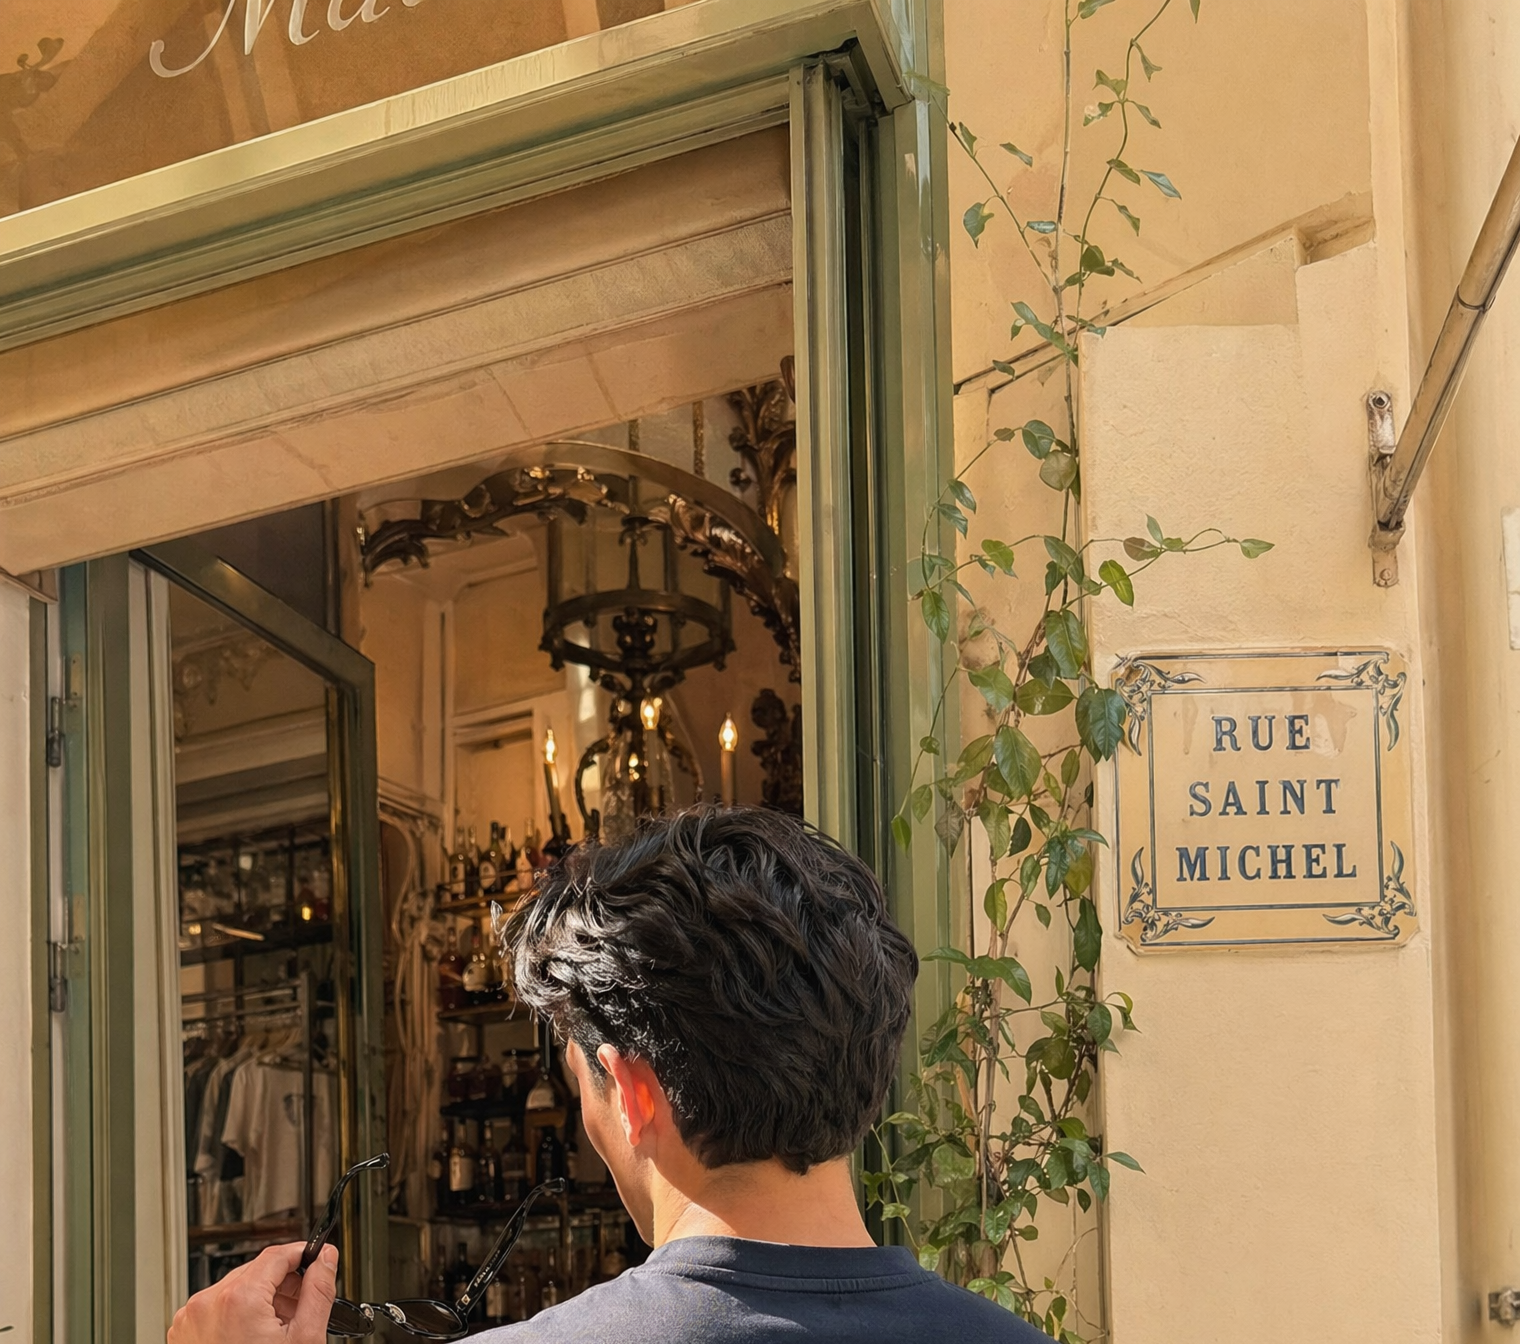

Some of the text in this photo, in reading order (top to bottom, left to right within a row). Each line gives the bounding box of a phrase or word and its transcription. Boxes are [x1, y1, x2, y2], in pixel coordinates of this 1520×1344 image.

[1211, 714, 1311, 752] RUE
[1188, 778, 1341, 817] SAINT
[1175, 843, 1358, 882] MICHEL
